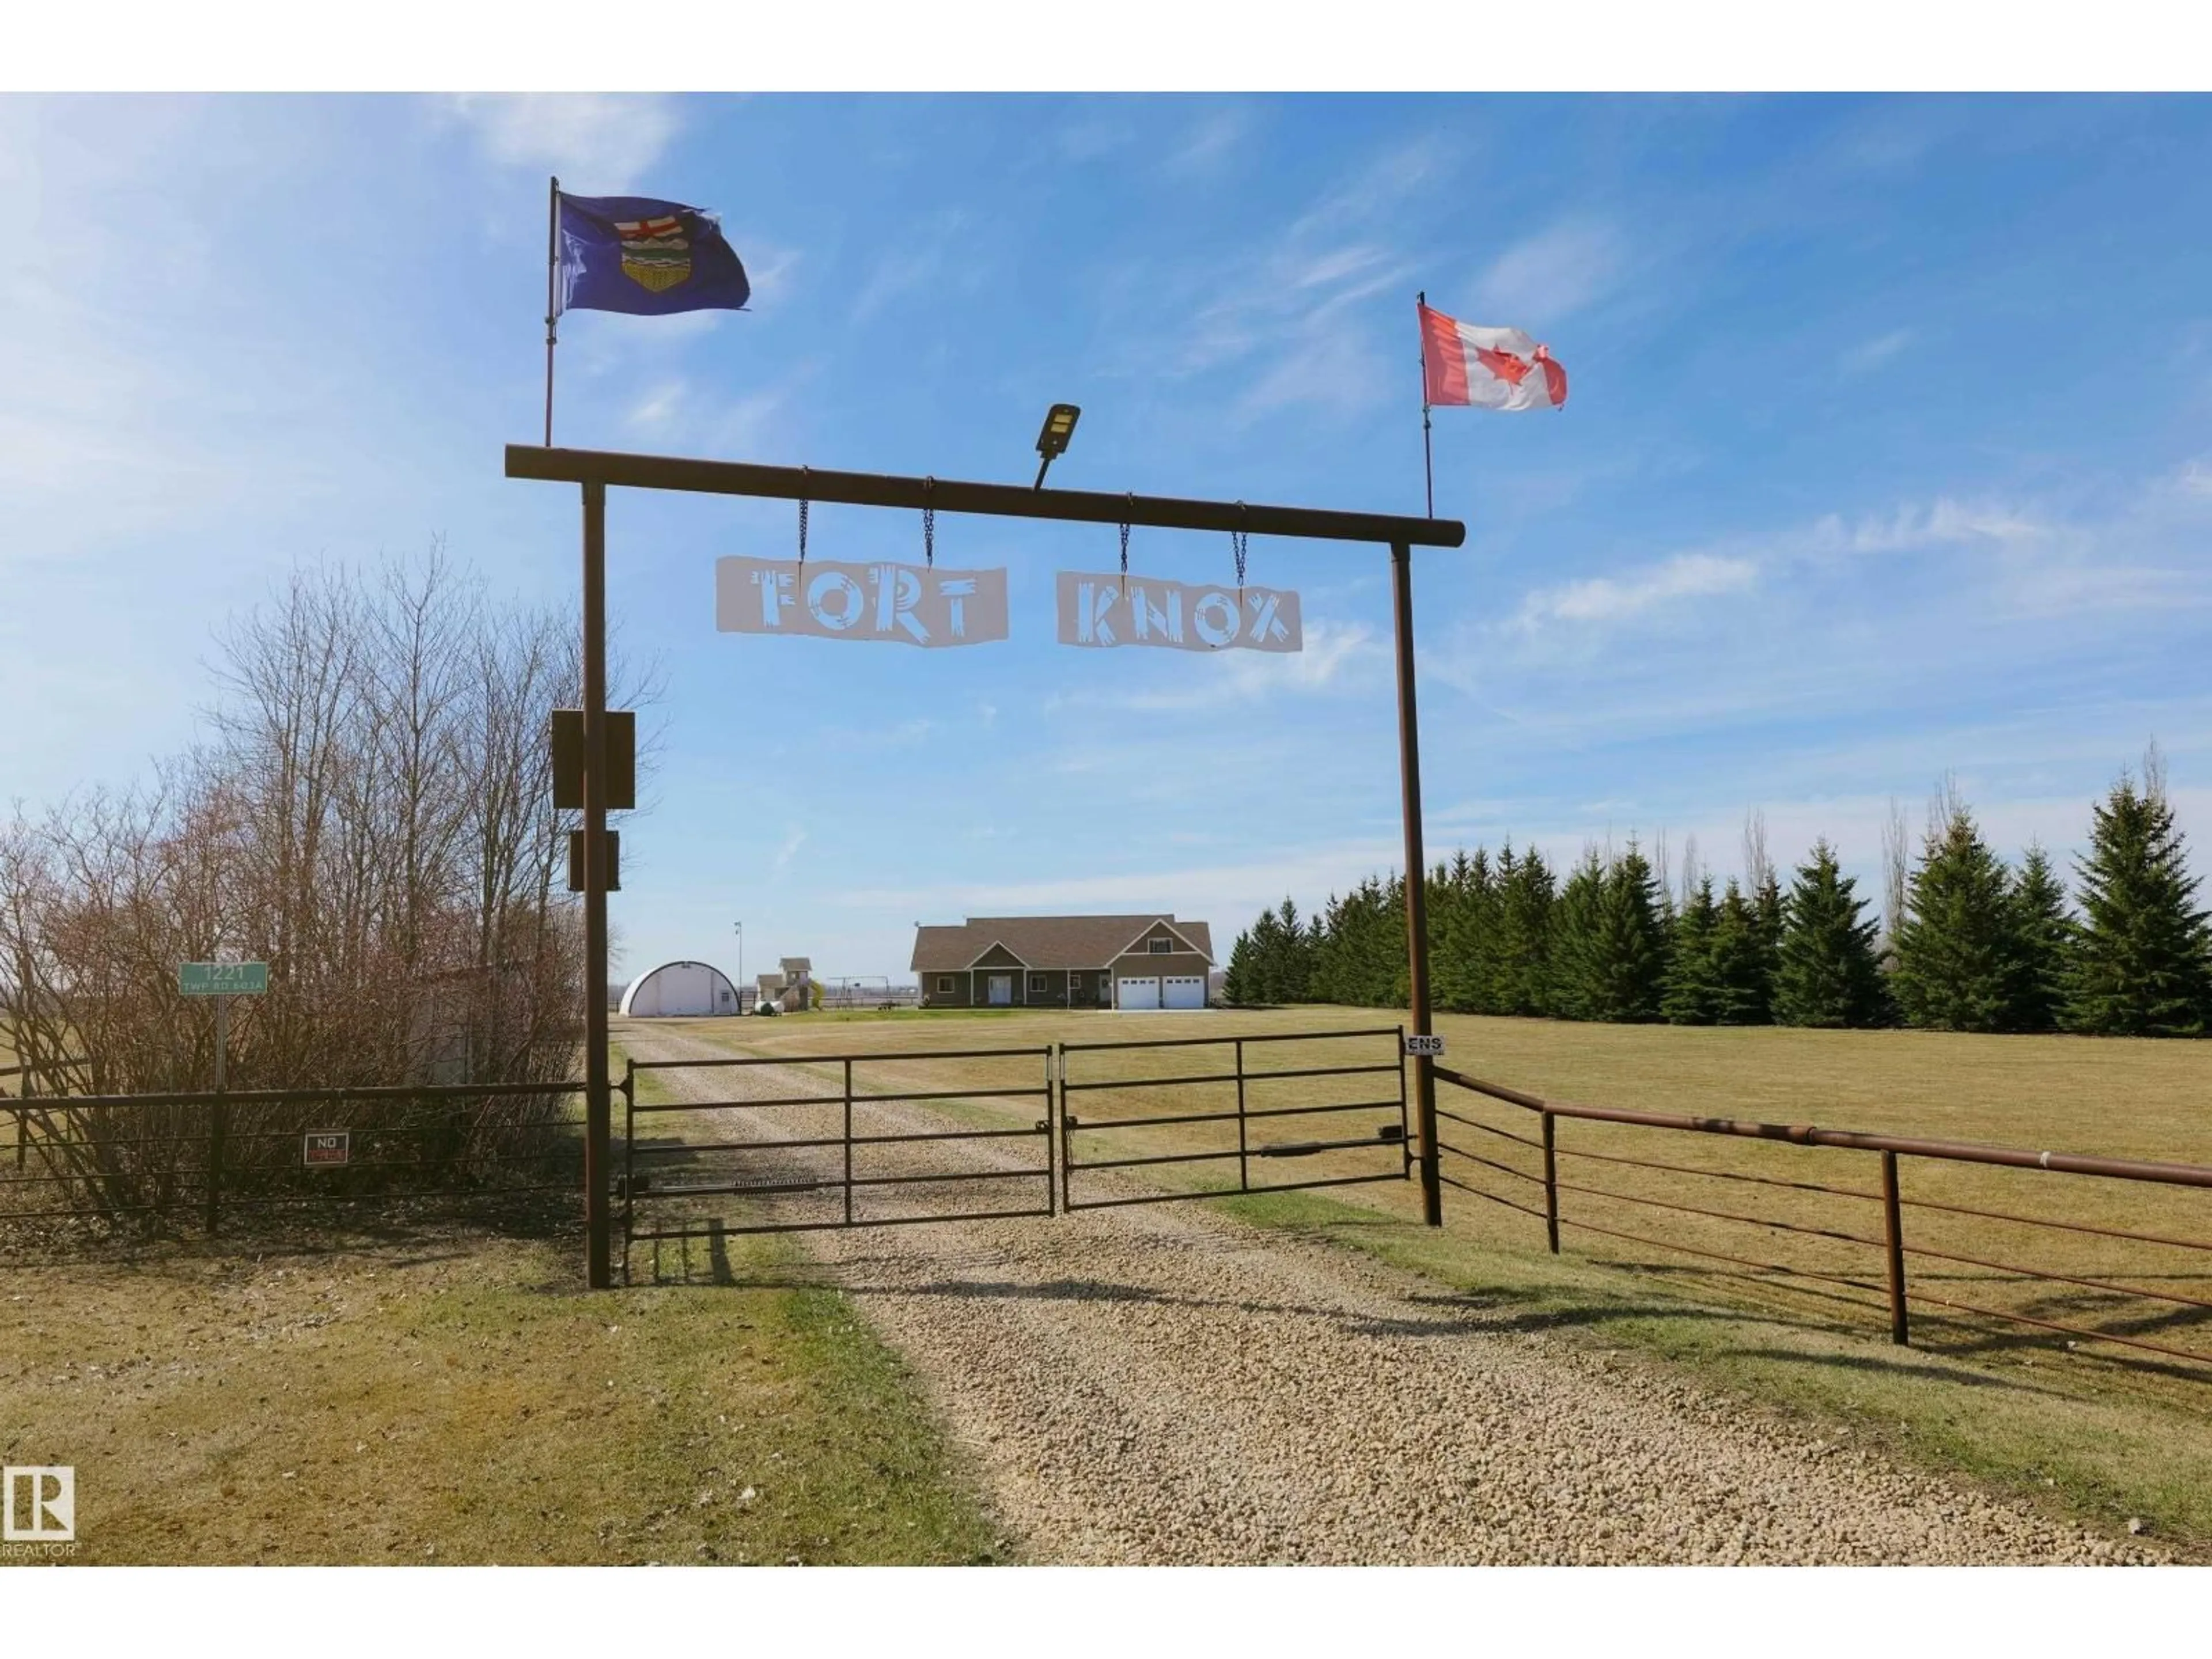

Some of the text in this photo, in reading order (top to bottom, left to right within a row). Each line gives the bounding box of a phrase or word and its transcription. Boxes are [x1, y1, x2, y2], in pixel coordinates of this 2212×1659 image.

[751, 564, 1290, 646] FORT KNOX
[204, 965, 244, 980] 1221
[182, 982, 209, 991] TWP
[1408, 1038, 1442, 1049] ENS
[317, 1137, 336, 1148] NO
